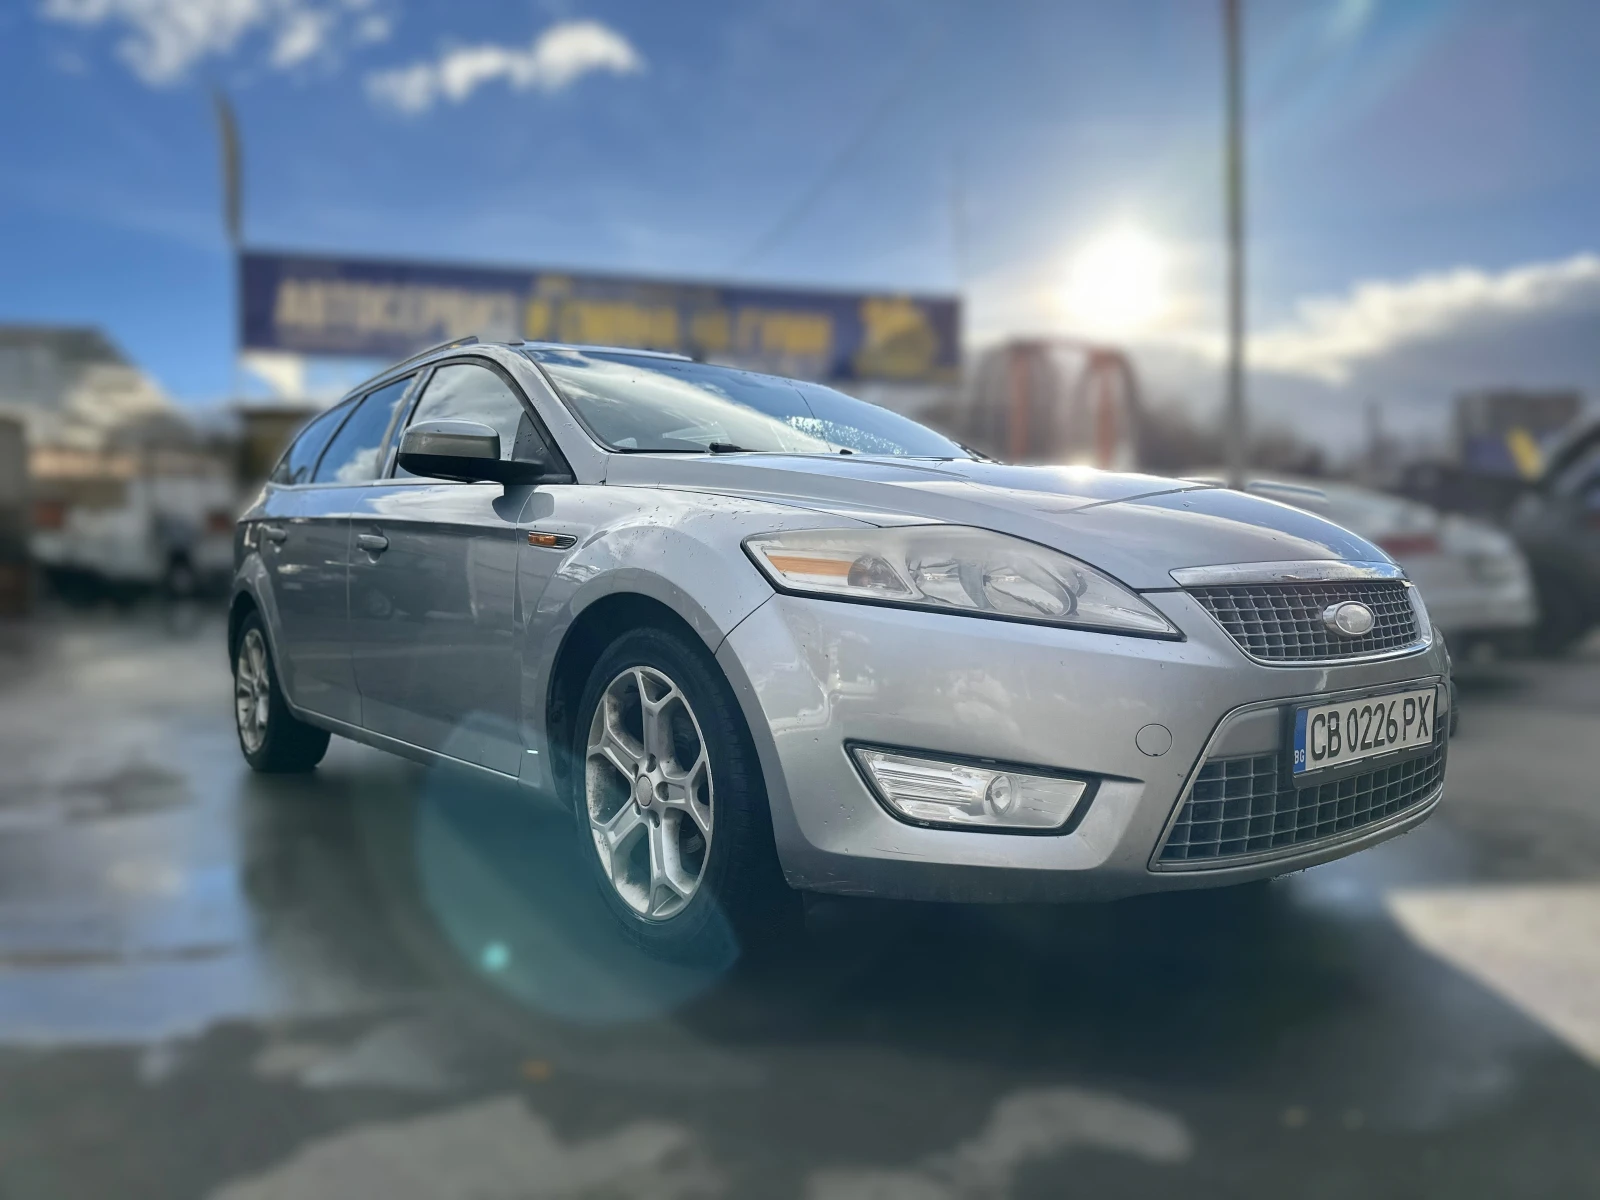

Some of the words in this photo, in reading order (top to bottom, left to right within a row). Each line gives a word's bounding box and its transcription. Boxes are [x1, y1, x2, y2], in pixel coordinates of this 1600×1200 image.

[1311, 710, 1341, 761] CB
[1346, 700, 1398, 753] 0226
[1402, 695, 1431, 741] PX
[1294, 749, 1305, 764] BG
